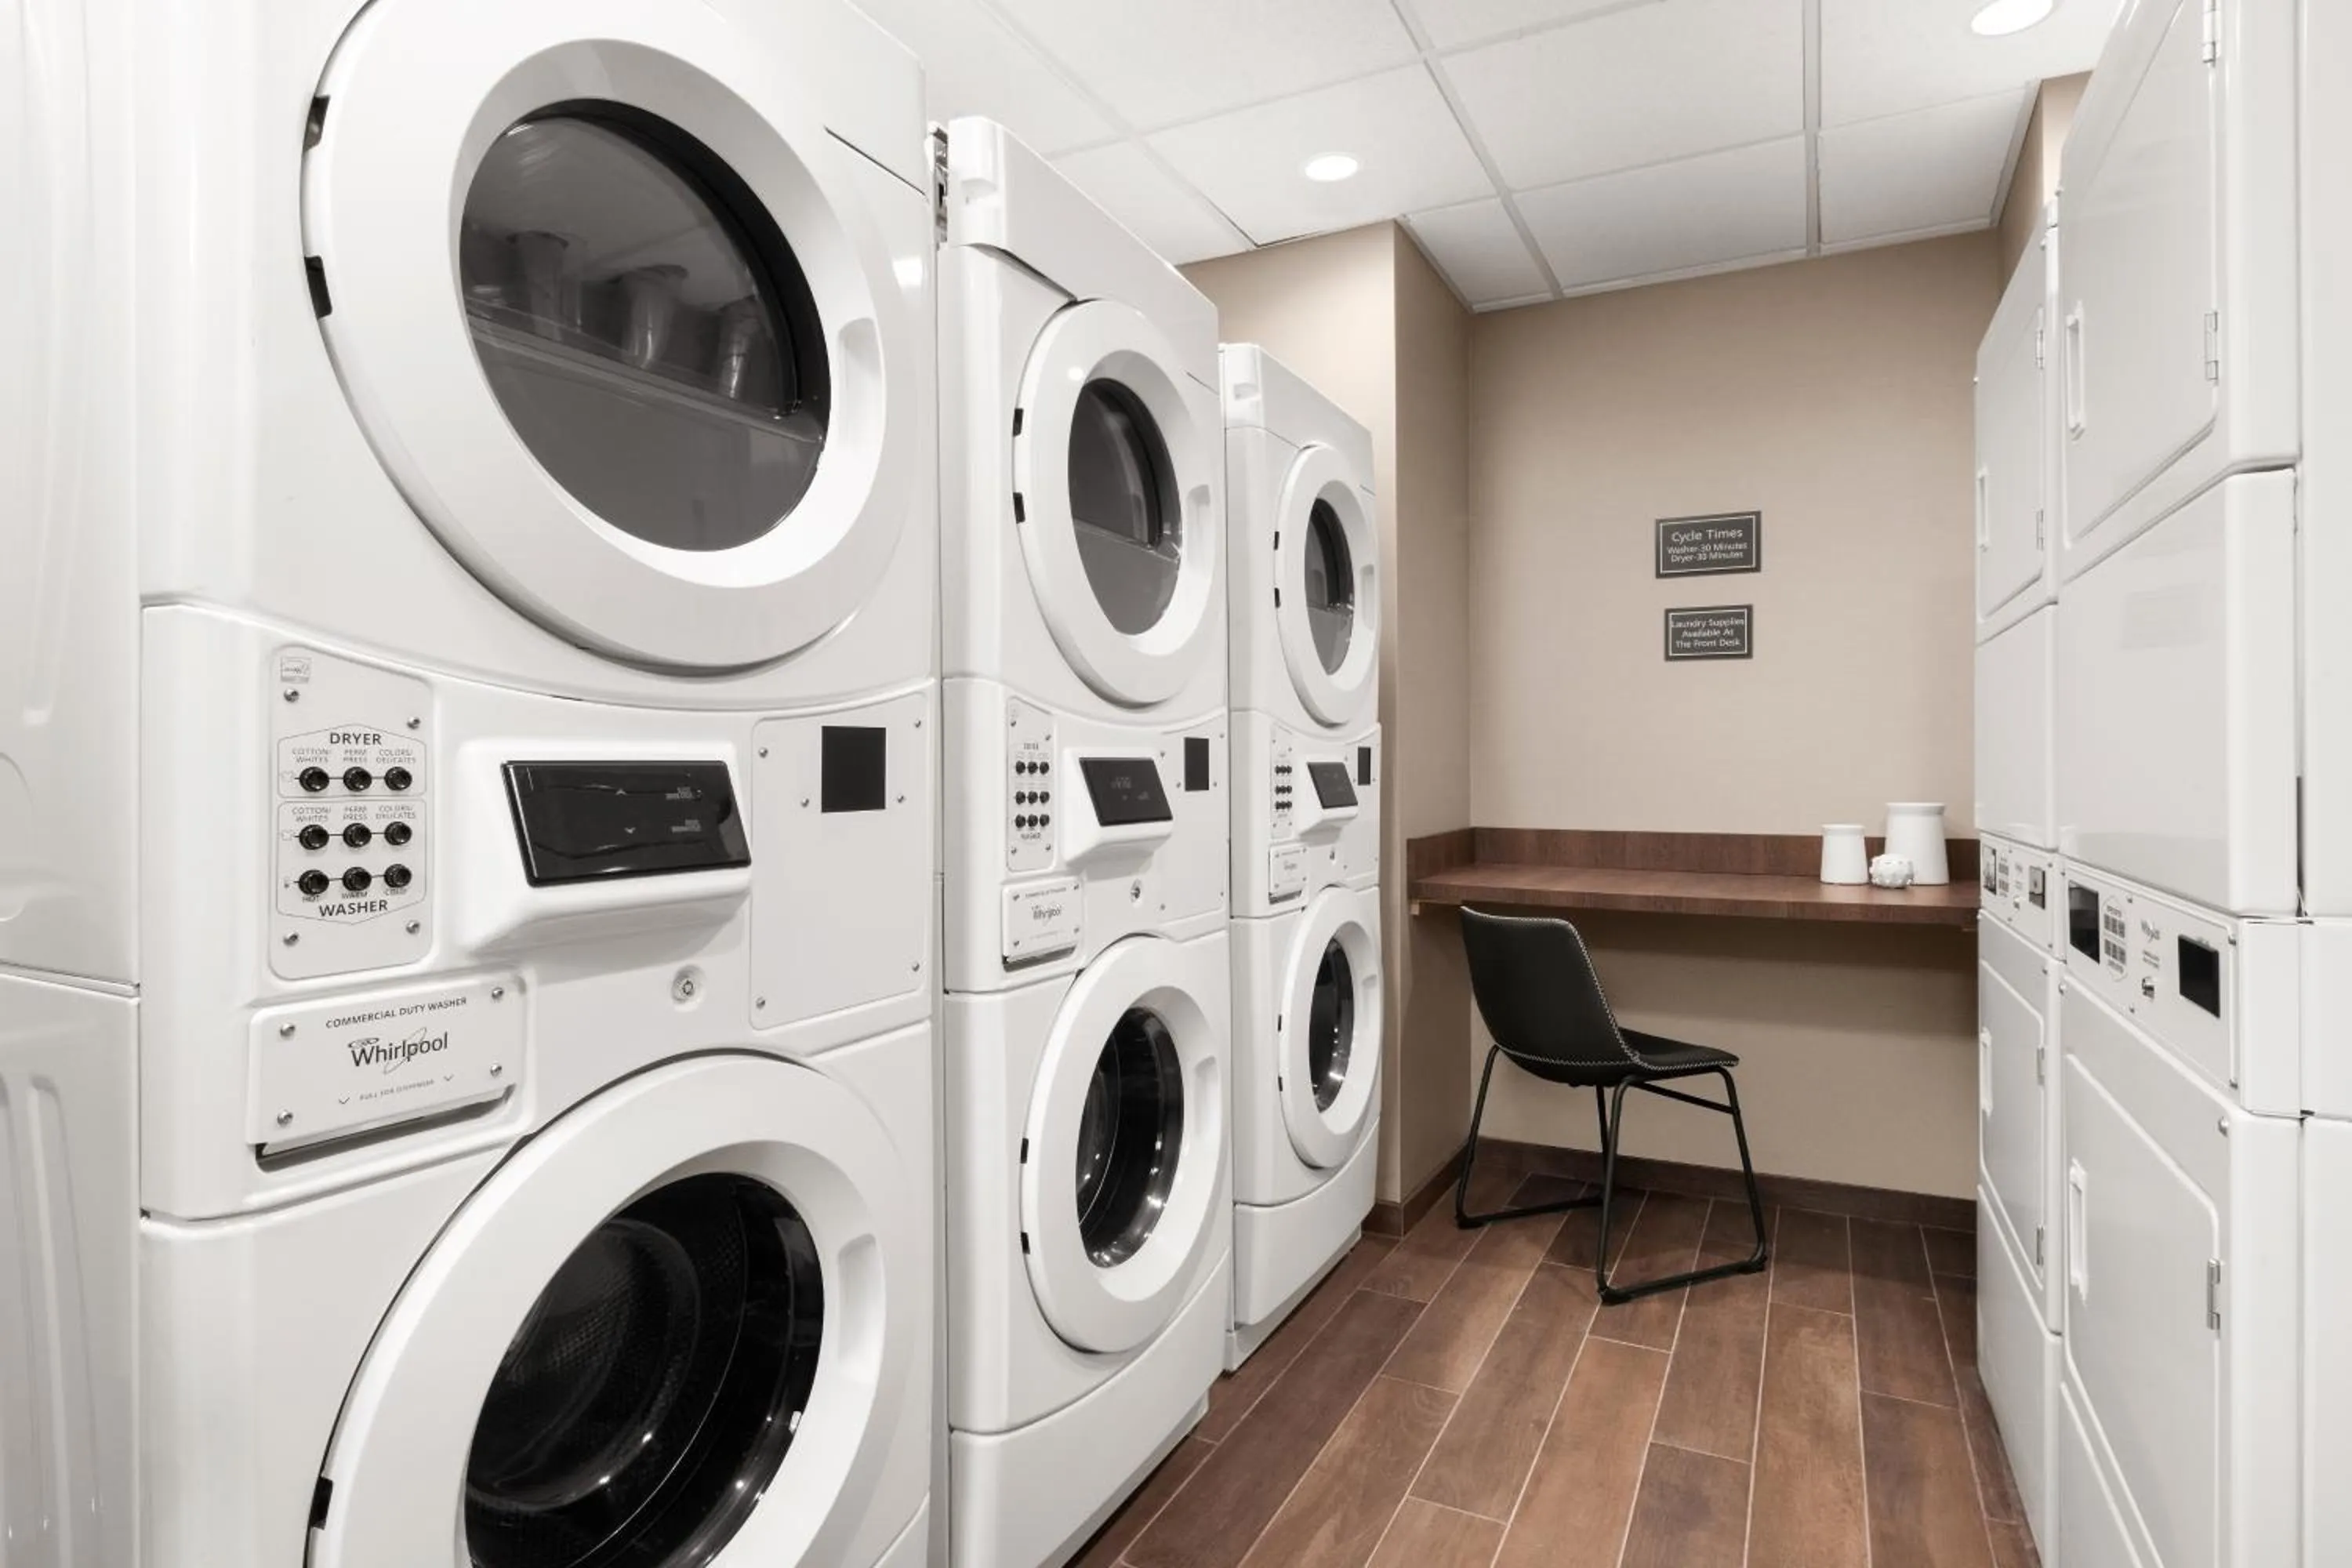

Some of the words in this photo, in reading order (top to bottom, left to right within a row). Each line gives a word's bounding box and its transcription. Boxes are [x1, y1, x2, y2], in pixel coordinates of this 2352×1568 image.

[1671, 530, 1702, 545] Cycle
[1706, 528, 1743, 539] Times
[1714, 542, 1748, 551] Minutes
[330, 732, 382, 745] DRYER
[319, 899, 388, 916] WASHER
[325, 1009, 396, 1029] COMMERCIAL
[399, 1004, 426, 1016] DUTY
[427, 996, 467, 1011] WASHER
[350, 1031, 448, 1067] Whirlpool
